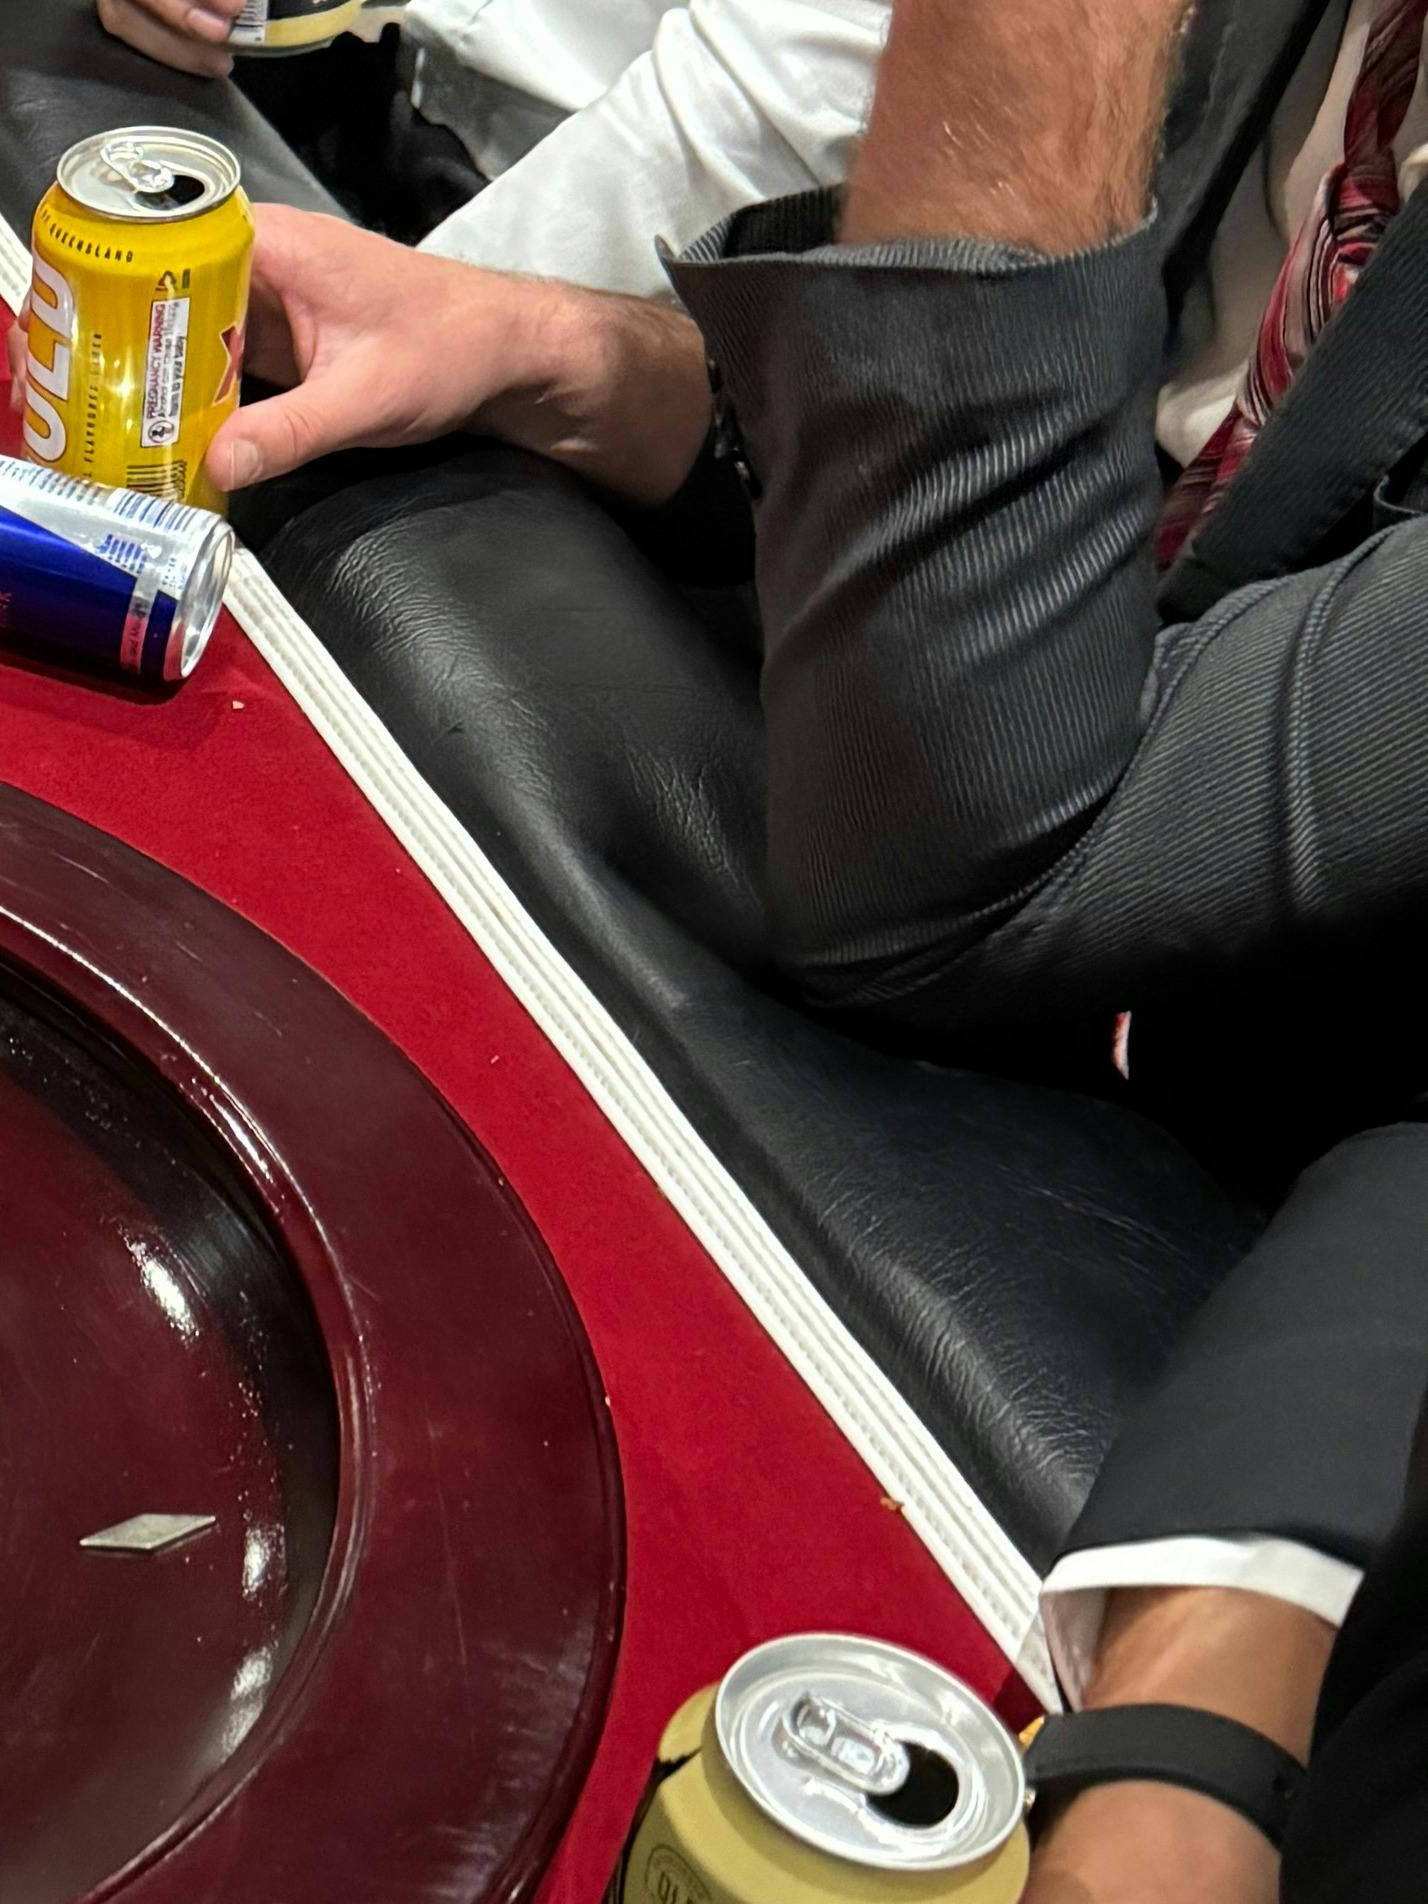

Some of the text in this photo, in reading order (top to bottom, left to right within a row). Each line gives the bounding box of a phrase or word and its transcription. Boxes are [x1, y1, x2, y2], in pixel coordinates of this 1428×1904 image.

[24, 251, 76, 464] OLD
[146, 303, 166, 420] PREGNANCY WARNING
